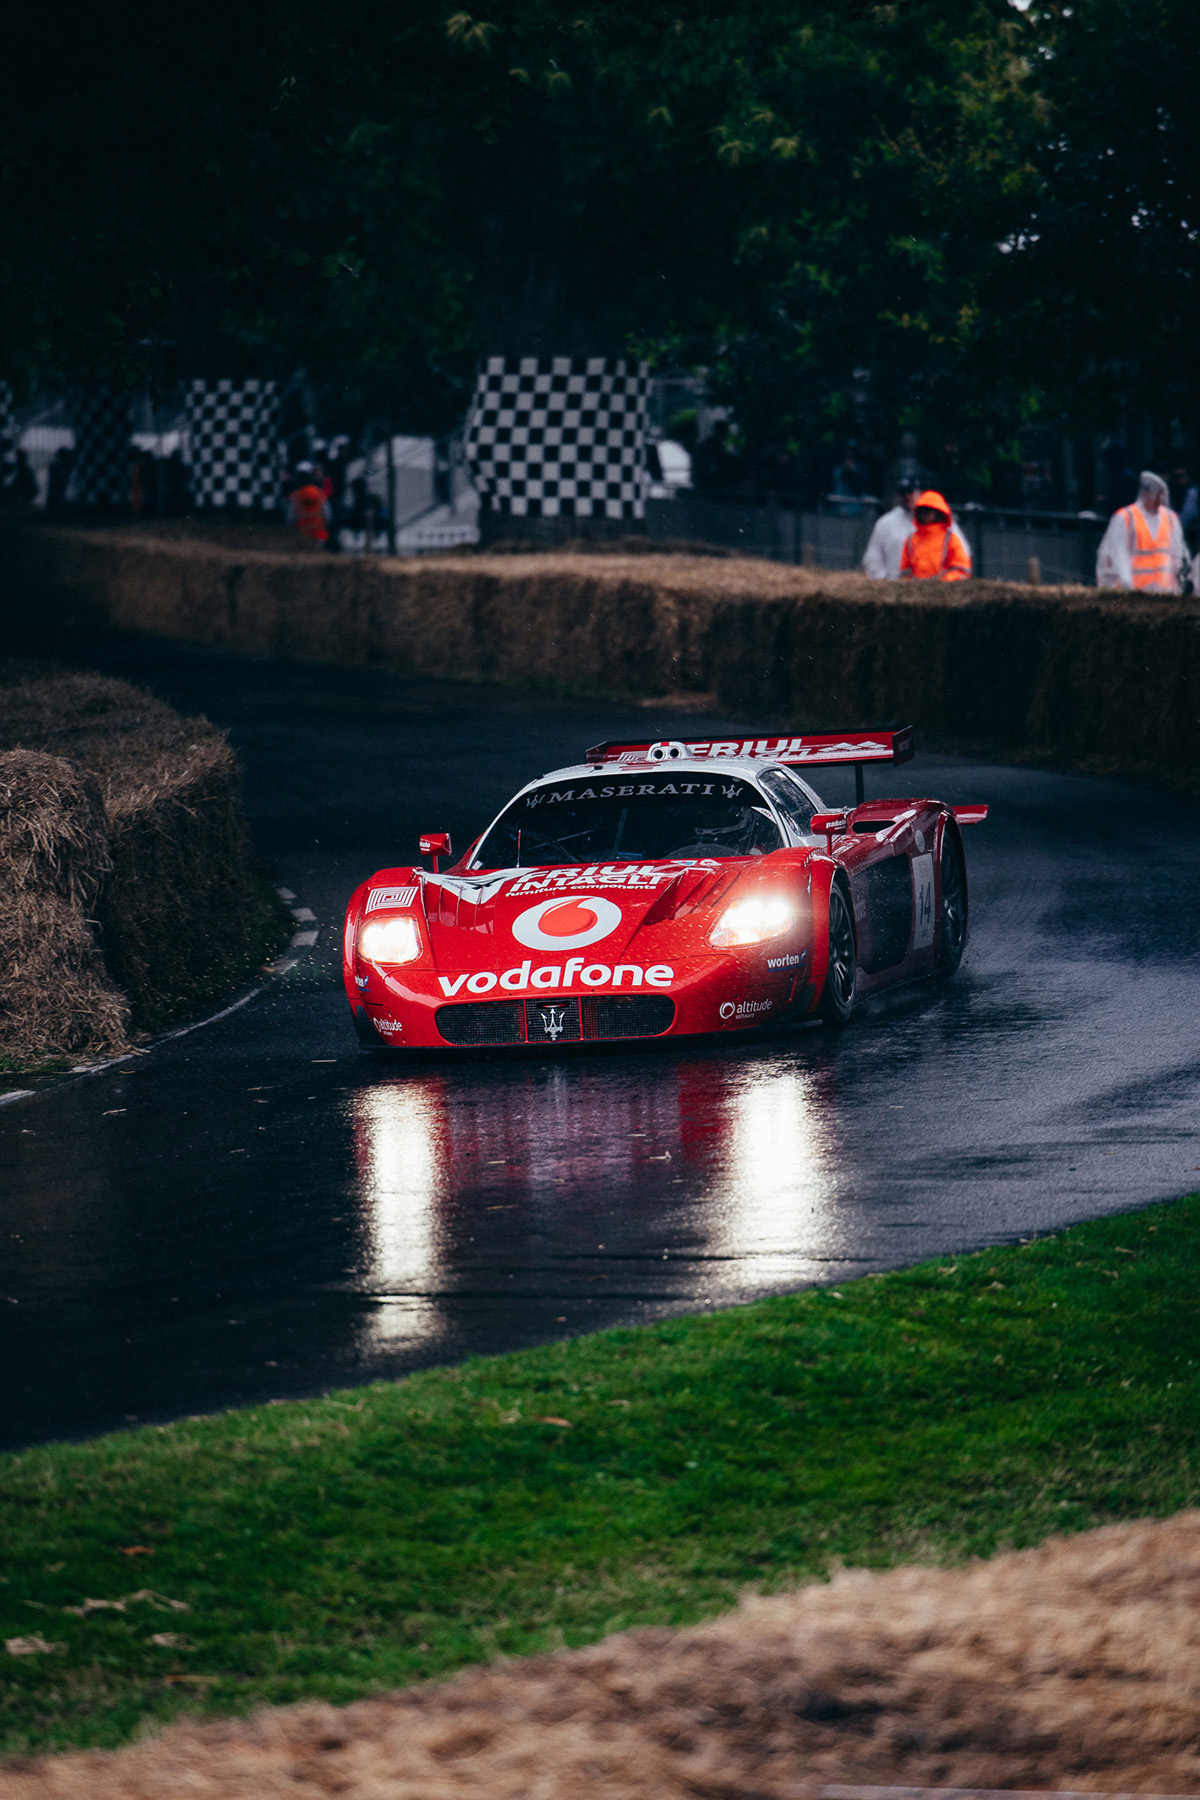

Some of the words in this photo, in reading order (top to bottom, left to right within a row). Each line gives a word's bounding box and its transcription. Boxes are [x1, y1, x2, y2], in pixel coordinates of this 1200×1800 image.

[546, 784, 715, 804] MASERATI
[517, 865, 665, 883] FRIUL
[505, 886, 567, 897] furniture
[918, 881, 931, 925] 14
[767, 953, 799, 969] worten
[438, 957, 674, 997] vodafone
[736, 999, 772, 1014] altitude
